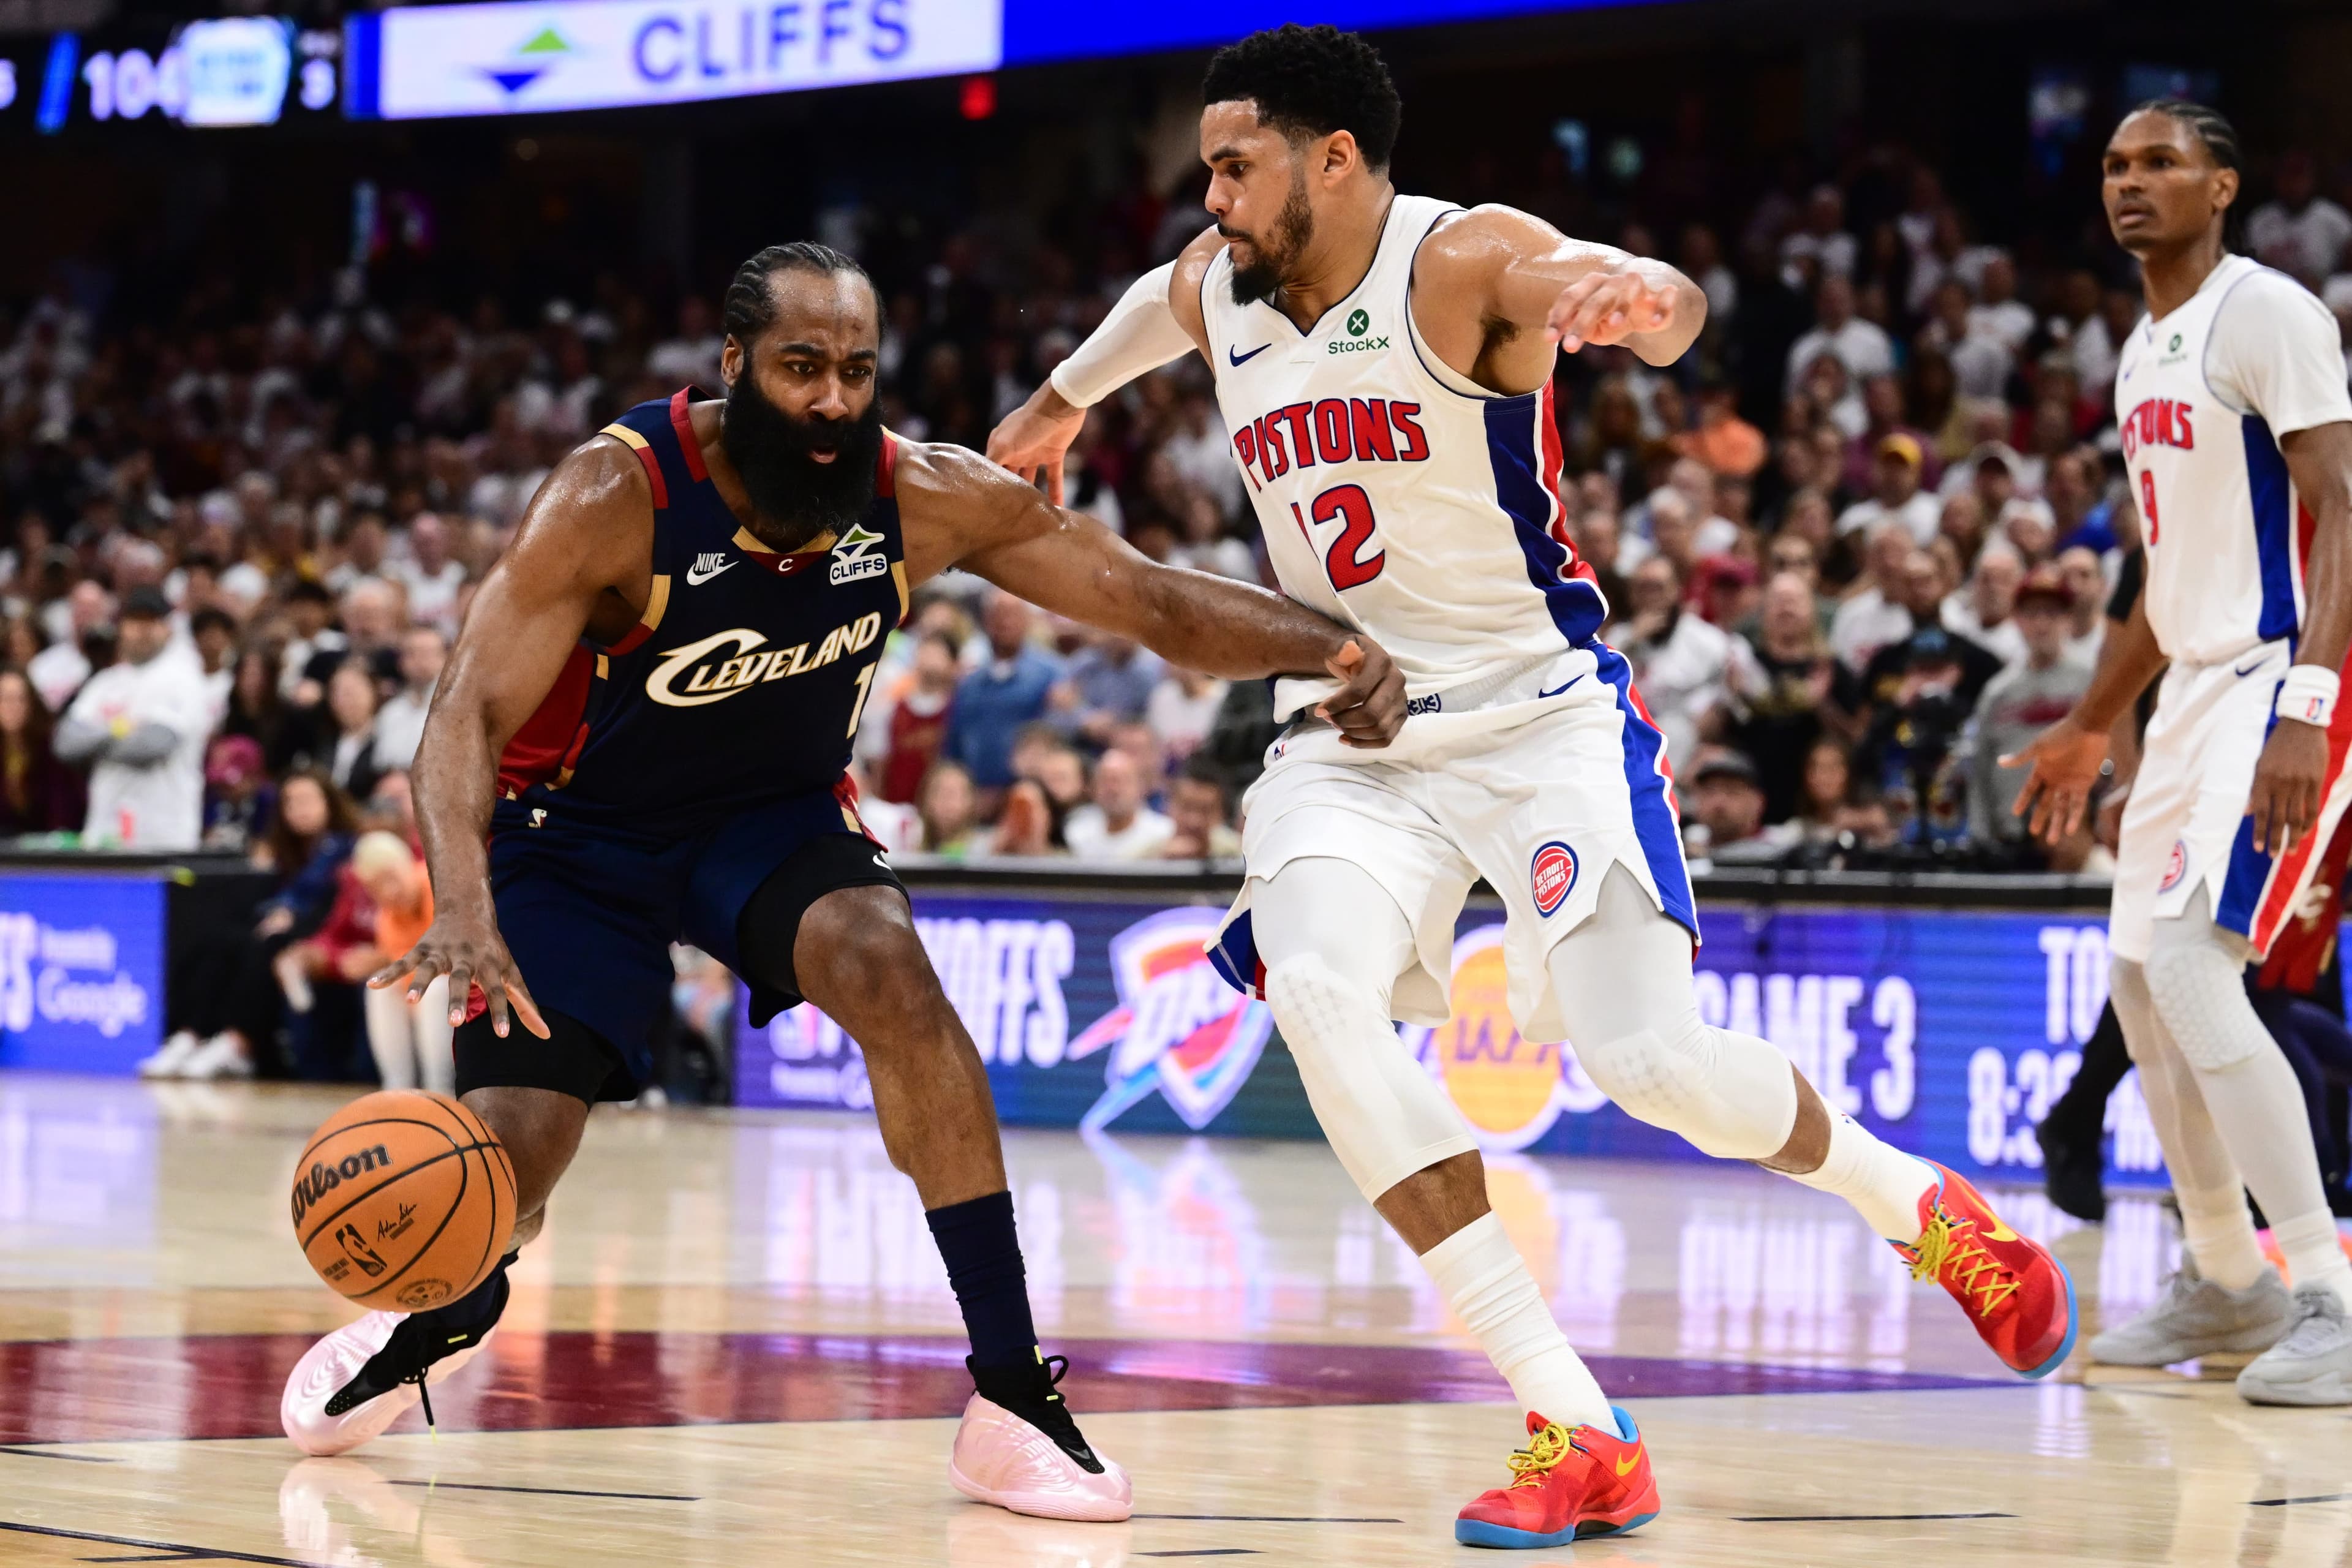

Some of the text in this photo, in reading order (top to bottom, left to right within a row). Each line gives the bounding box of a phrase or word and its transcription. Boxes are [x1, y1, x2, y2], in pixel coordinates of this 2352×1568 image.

[633, 0, 910, 84] CLIFFS
[1328, 336, 1390, 355] StockX
[1233, 398, 1430, 493] PISTONS
[695, 552, 726, 571] NIKE
[778, 558, 794, 572] C
[831, 557, 886, 580] CLIFFS
[645, 611, 882, 707] CLEVELAND
[1536, 859, 1564, 888] DETROIT
[1537, 870, 1566, 899] PISTONS
[1870, 976, 1917, 1121] 3
